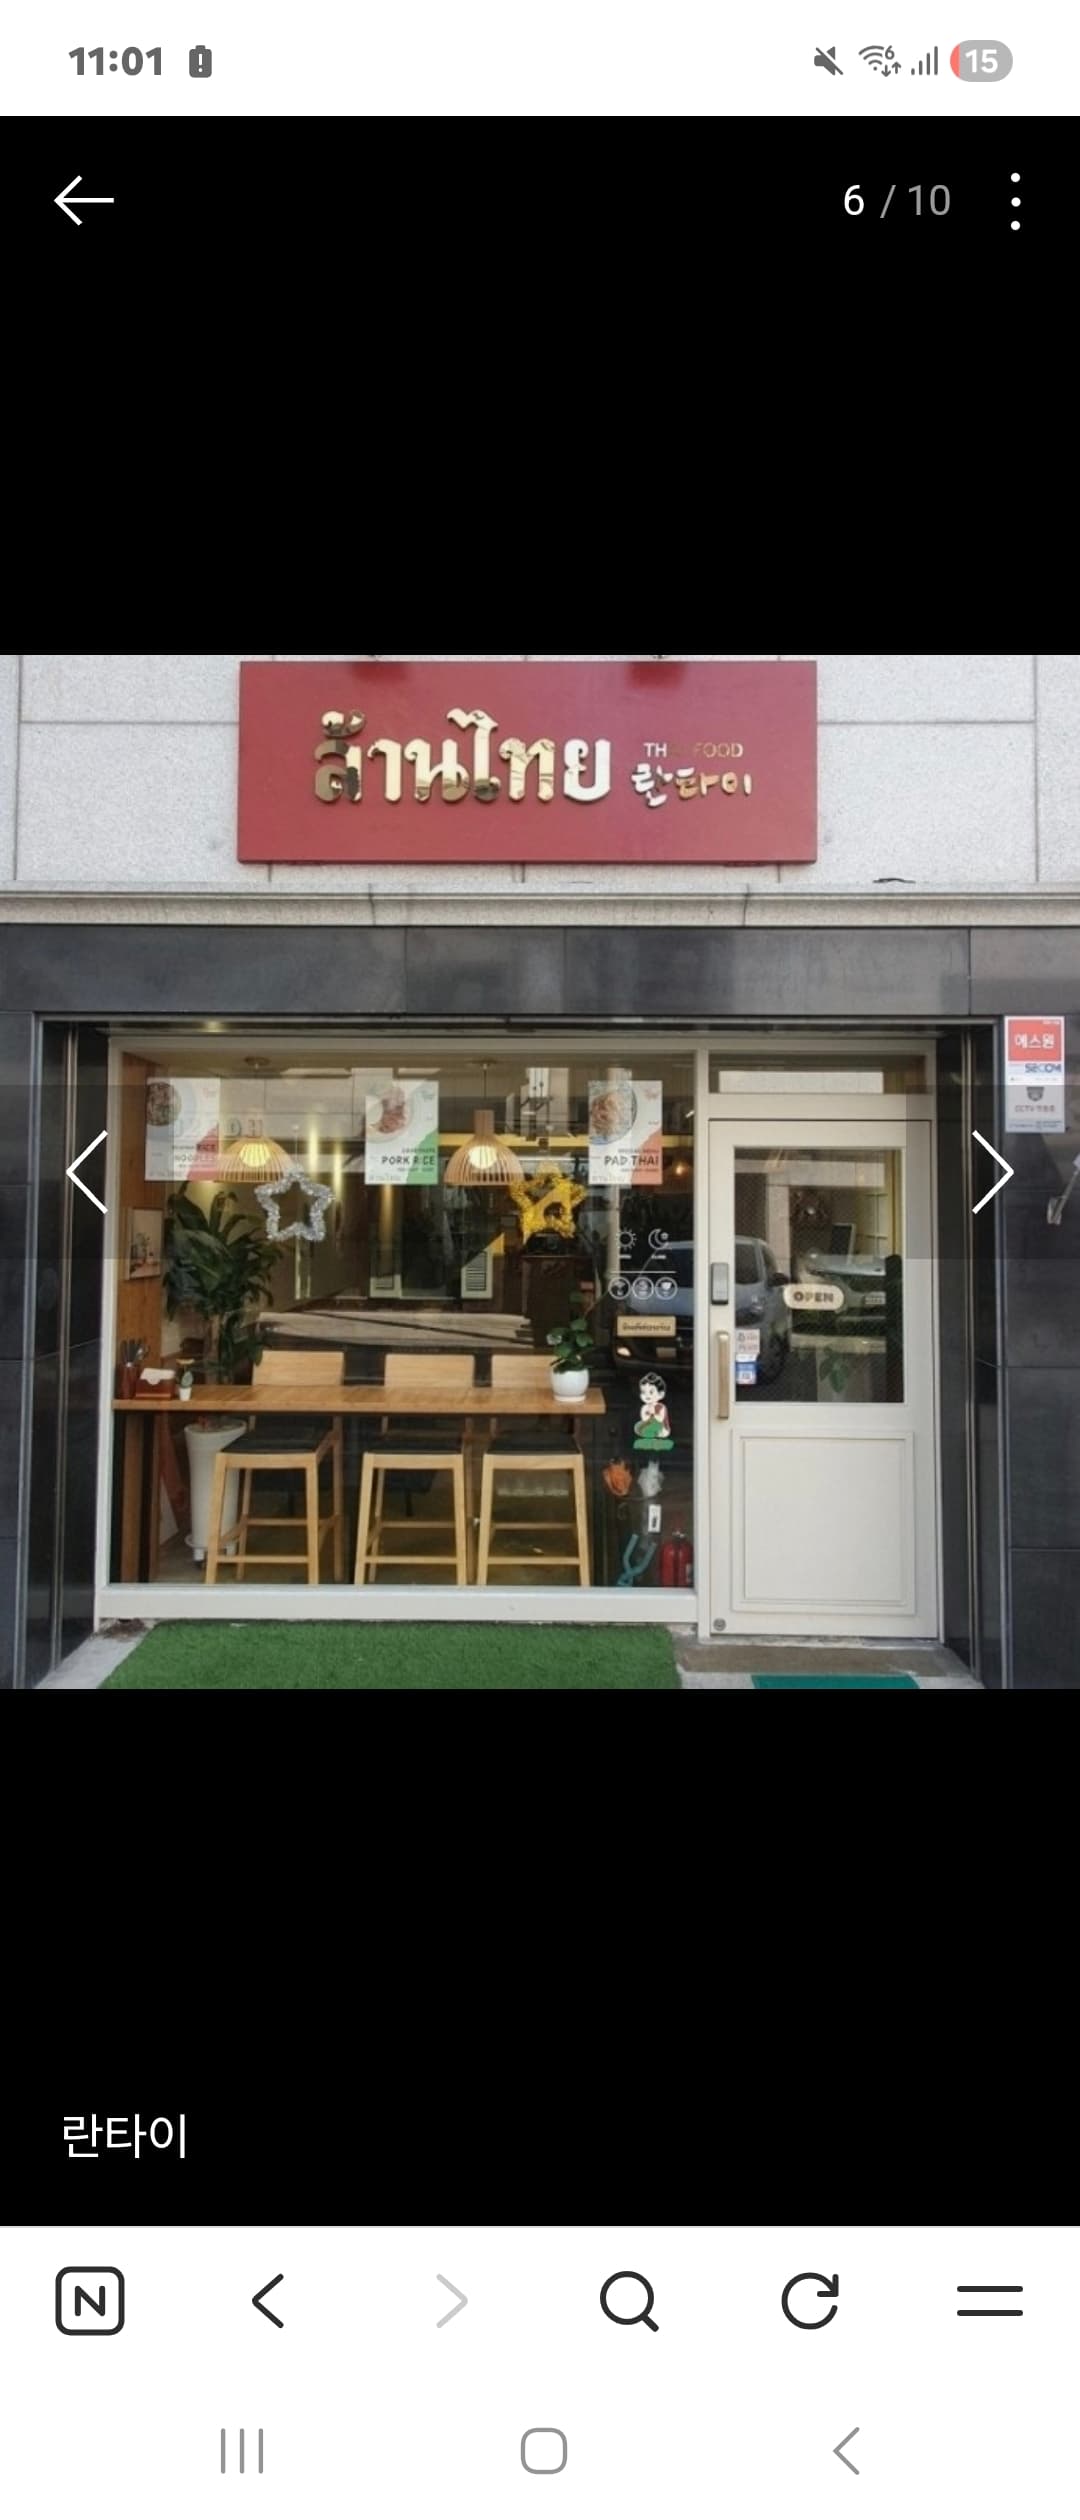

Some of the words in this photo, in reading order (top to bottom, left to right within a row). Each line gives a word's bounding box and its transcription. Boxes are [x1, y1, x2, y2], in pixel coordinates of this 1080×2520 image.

[693, 742, 744, 758] FOOD
[631, 762, 753, 808] 란타이
[1014, 1033, 1055, 1049] 에스원
[381, 1155, 410, 1166] PORK
[604, 1155, 629, 1167] PAD
[631, 1155, 659, 1167] THAI
[793, 1290, 834, 1304] OPEN
